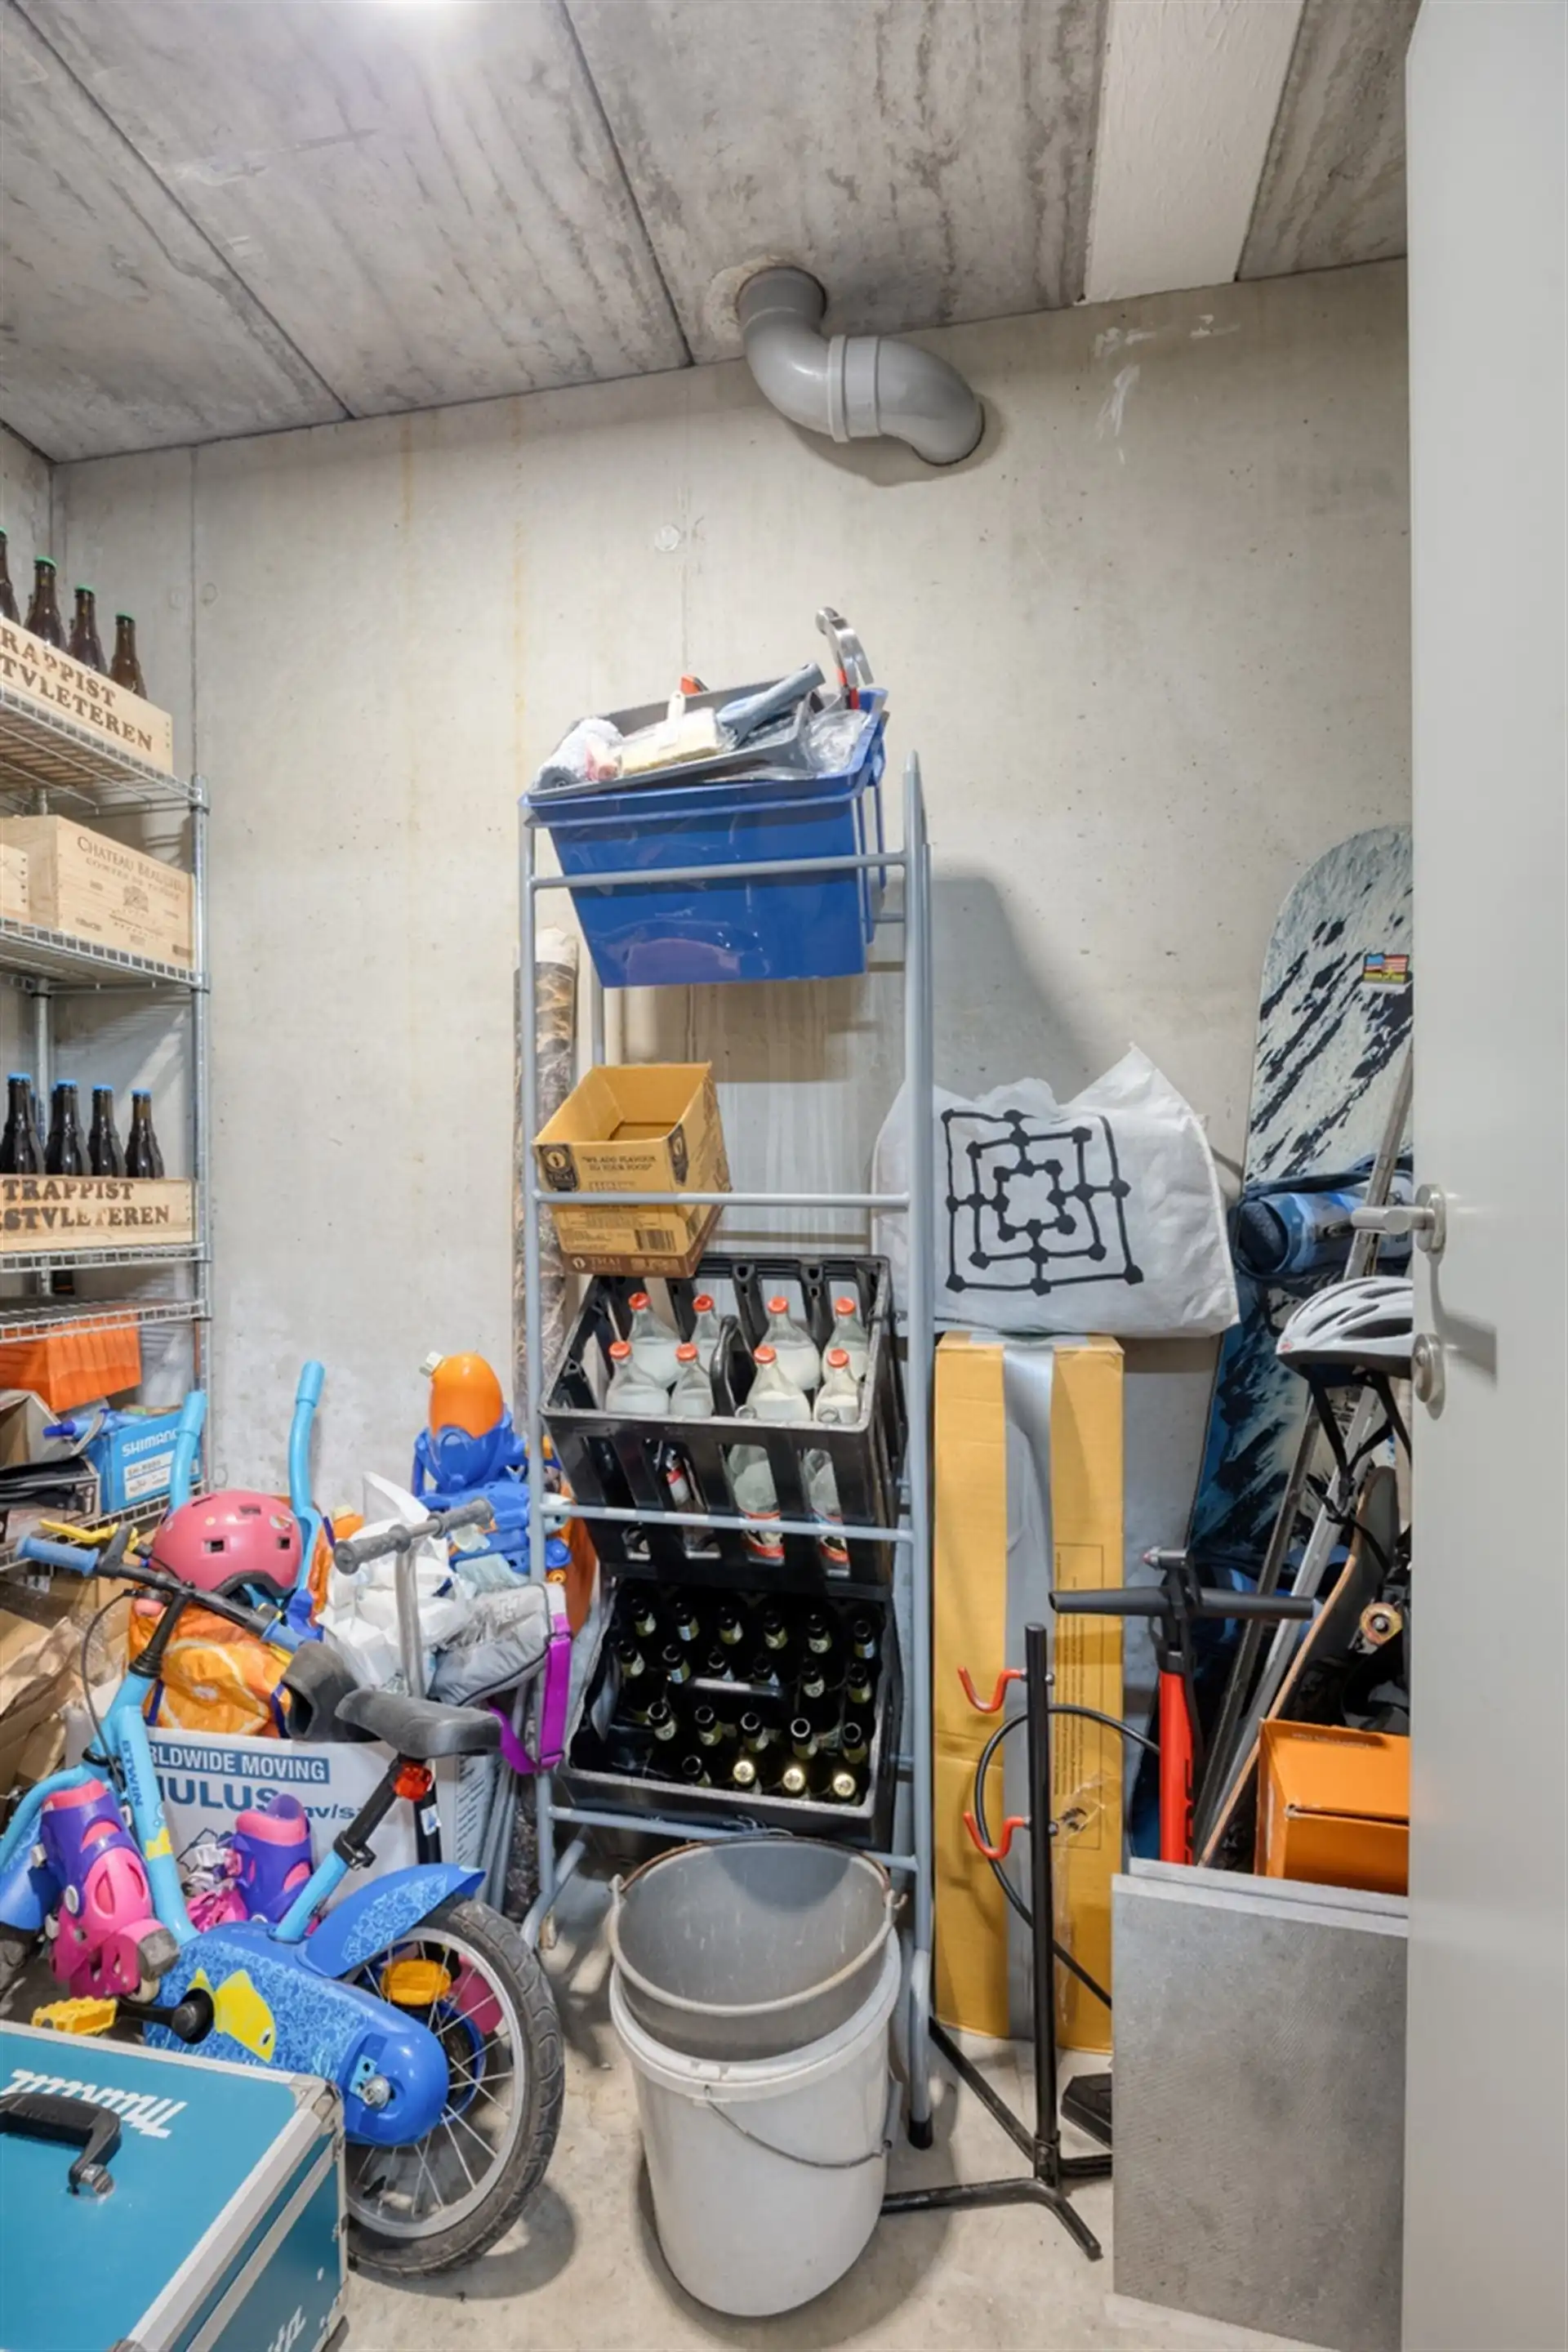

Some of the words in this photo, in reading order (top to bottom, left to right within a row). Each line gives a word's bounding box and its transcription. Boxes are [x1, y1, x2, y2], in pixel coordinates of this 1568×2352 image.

[2, 1179, 134, 1201] TRAPPIST
[0, 1205, 169, 1231] STVLETEREN
[242, 1754, 325, 1781] MOVING
